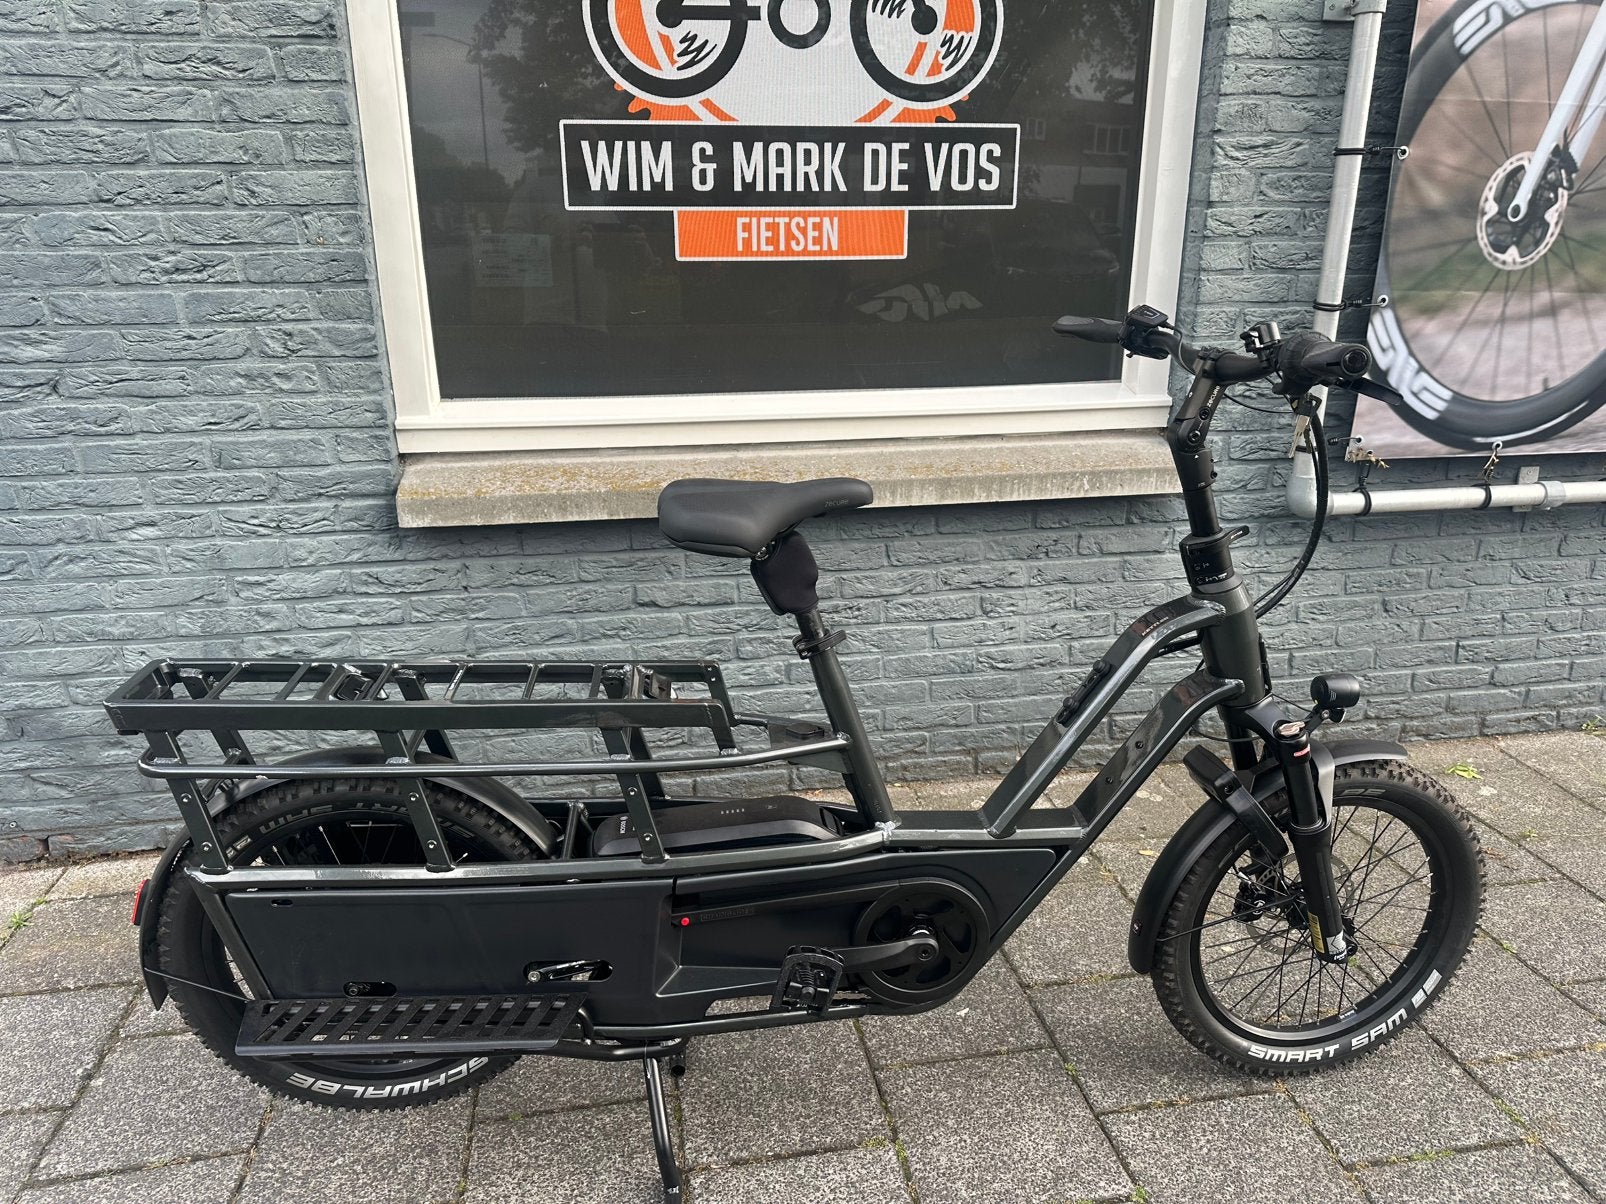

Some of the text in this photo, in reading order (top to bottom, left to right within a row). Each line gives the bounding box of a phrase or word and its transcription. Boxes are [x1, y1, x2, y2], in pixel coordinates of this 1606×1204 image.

[580, 140, 1002, 193] WIM & MARK DE VOS
[735, 216, 839, 252] FIETSEN
[1248, 1007, 1408, 1063] SMART SAM
[285, 1056, 489, 1099] SCHWALBE
